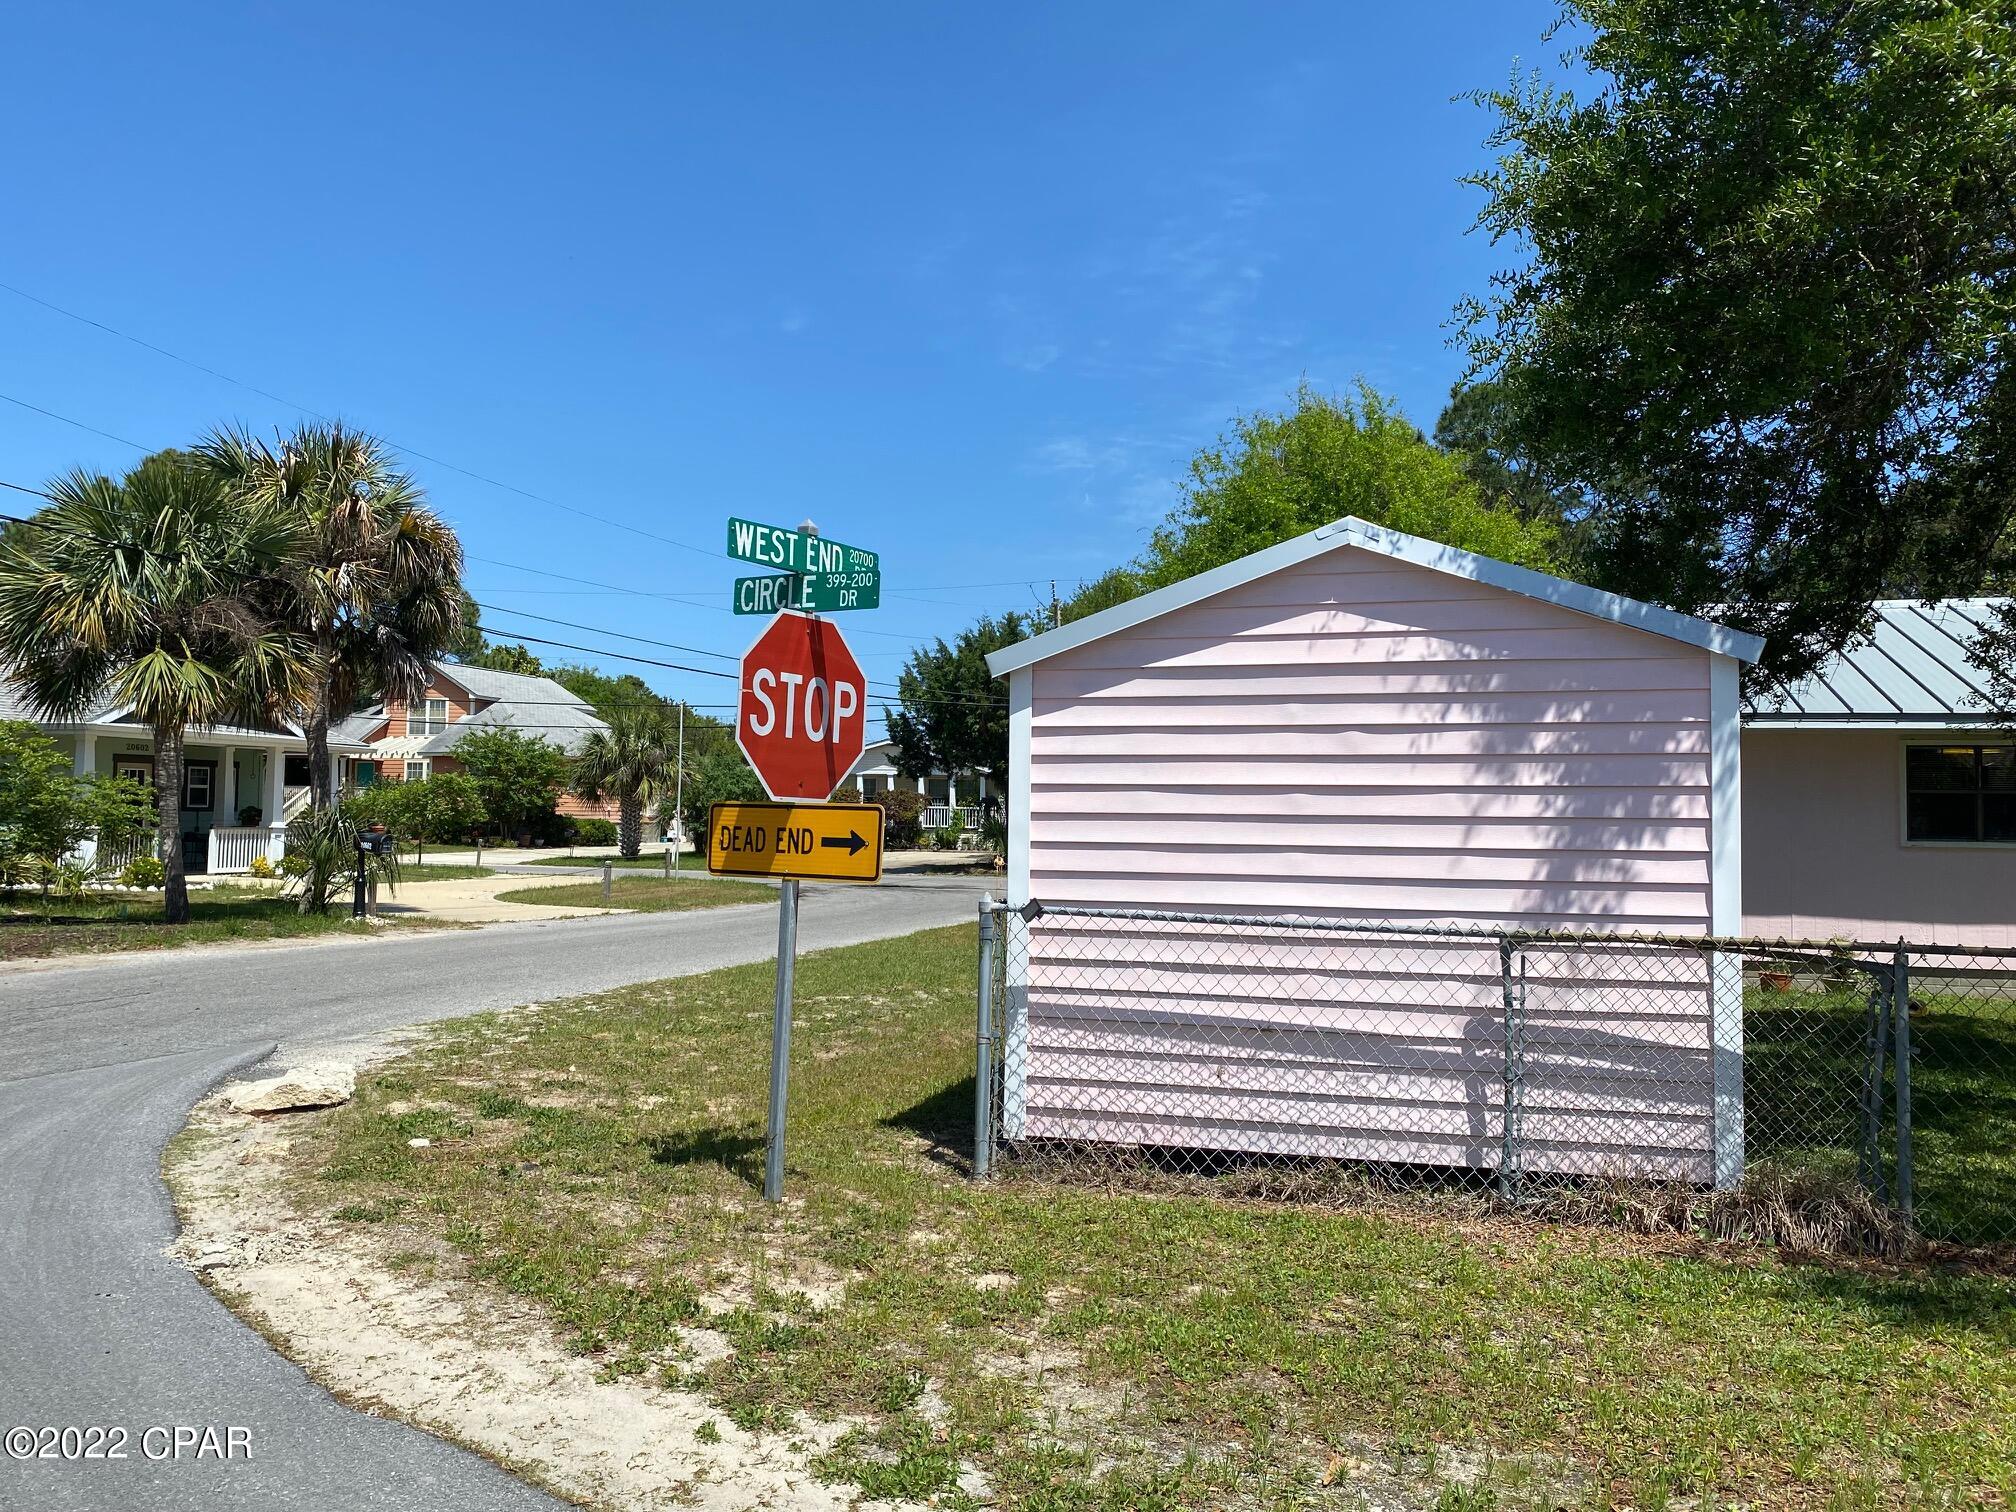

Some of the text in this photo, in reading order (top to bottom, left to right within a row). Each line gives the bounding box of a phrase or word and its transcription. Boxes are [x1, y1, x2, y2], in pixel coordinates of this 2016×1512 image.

[734, 521, 874, 572] WEST END 20700
[740, 575, 817, 612] CIRCLE
[826, 572, 873, 588] 399-200
[839, 590, 858, 607] DR
[749, 668, 858, 744] STOP
[720, 825, 814, 855] DEAD END
